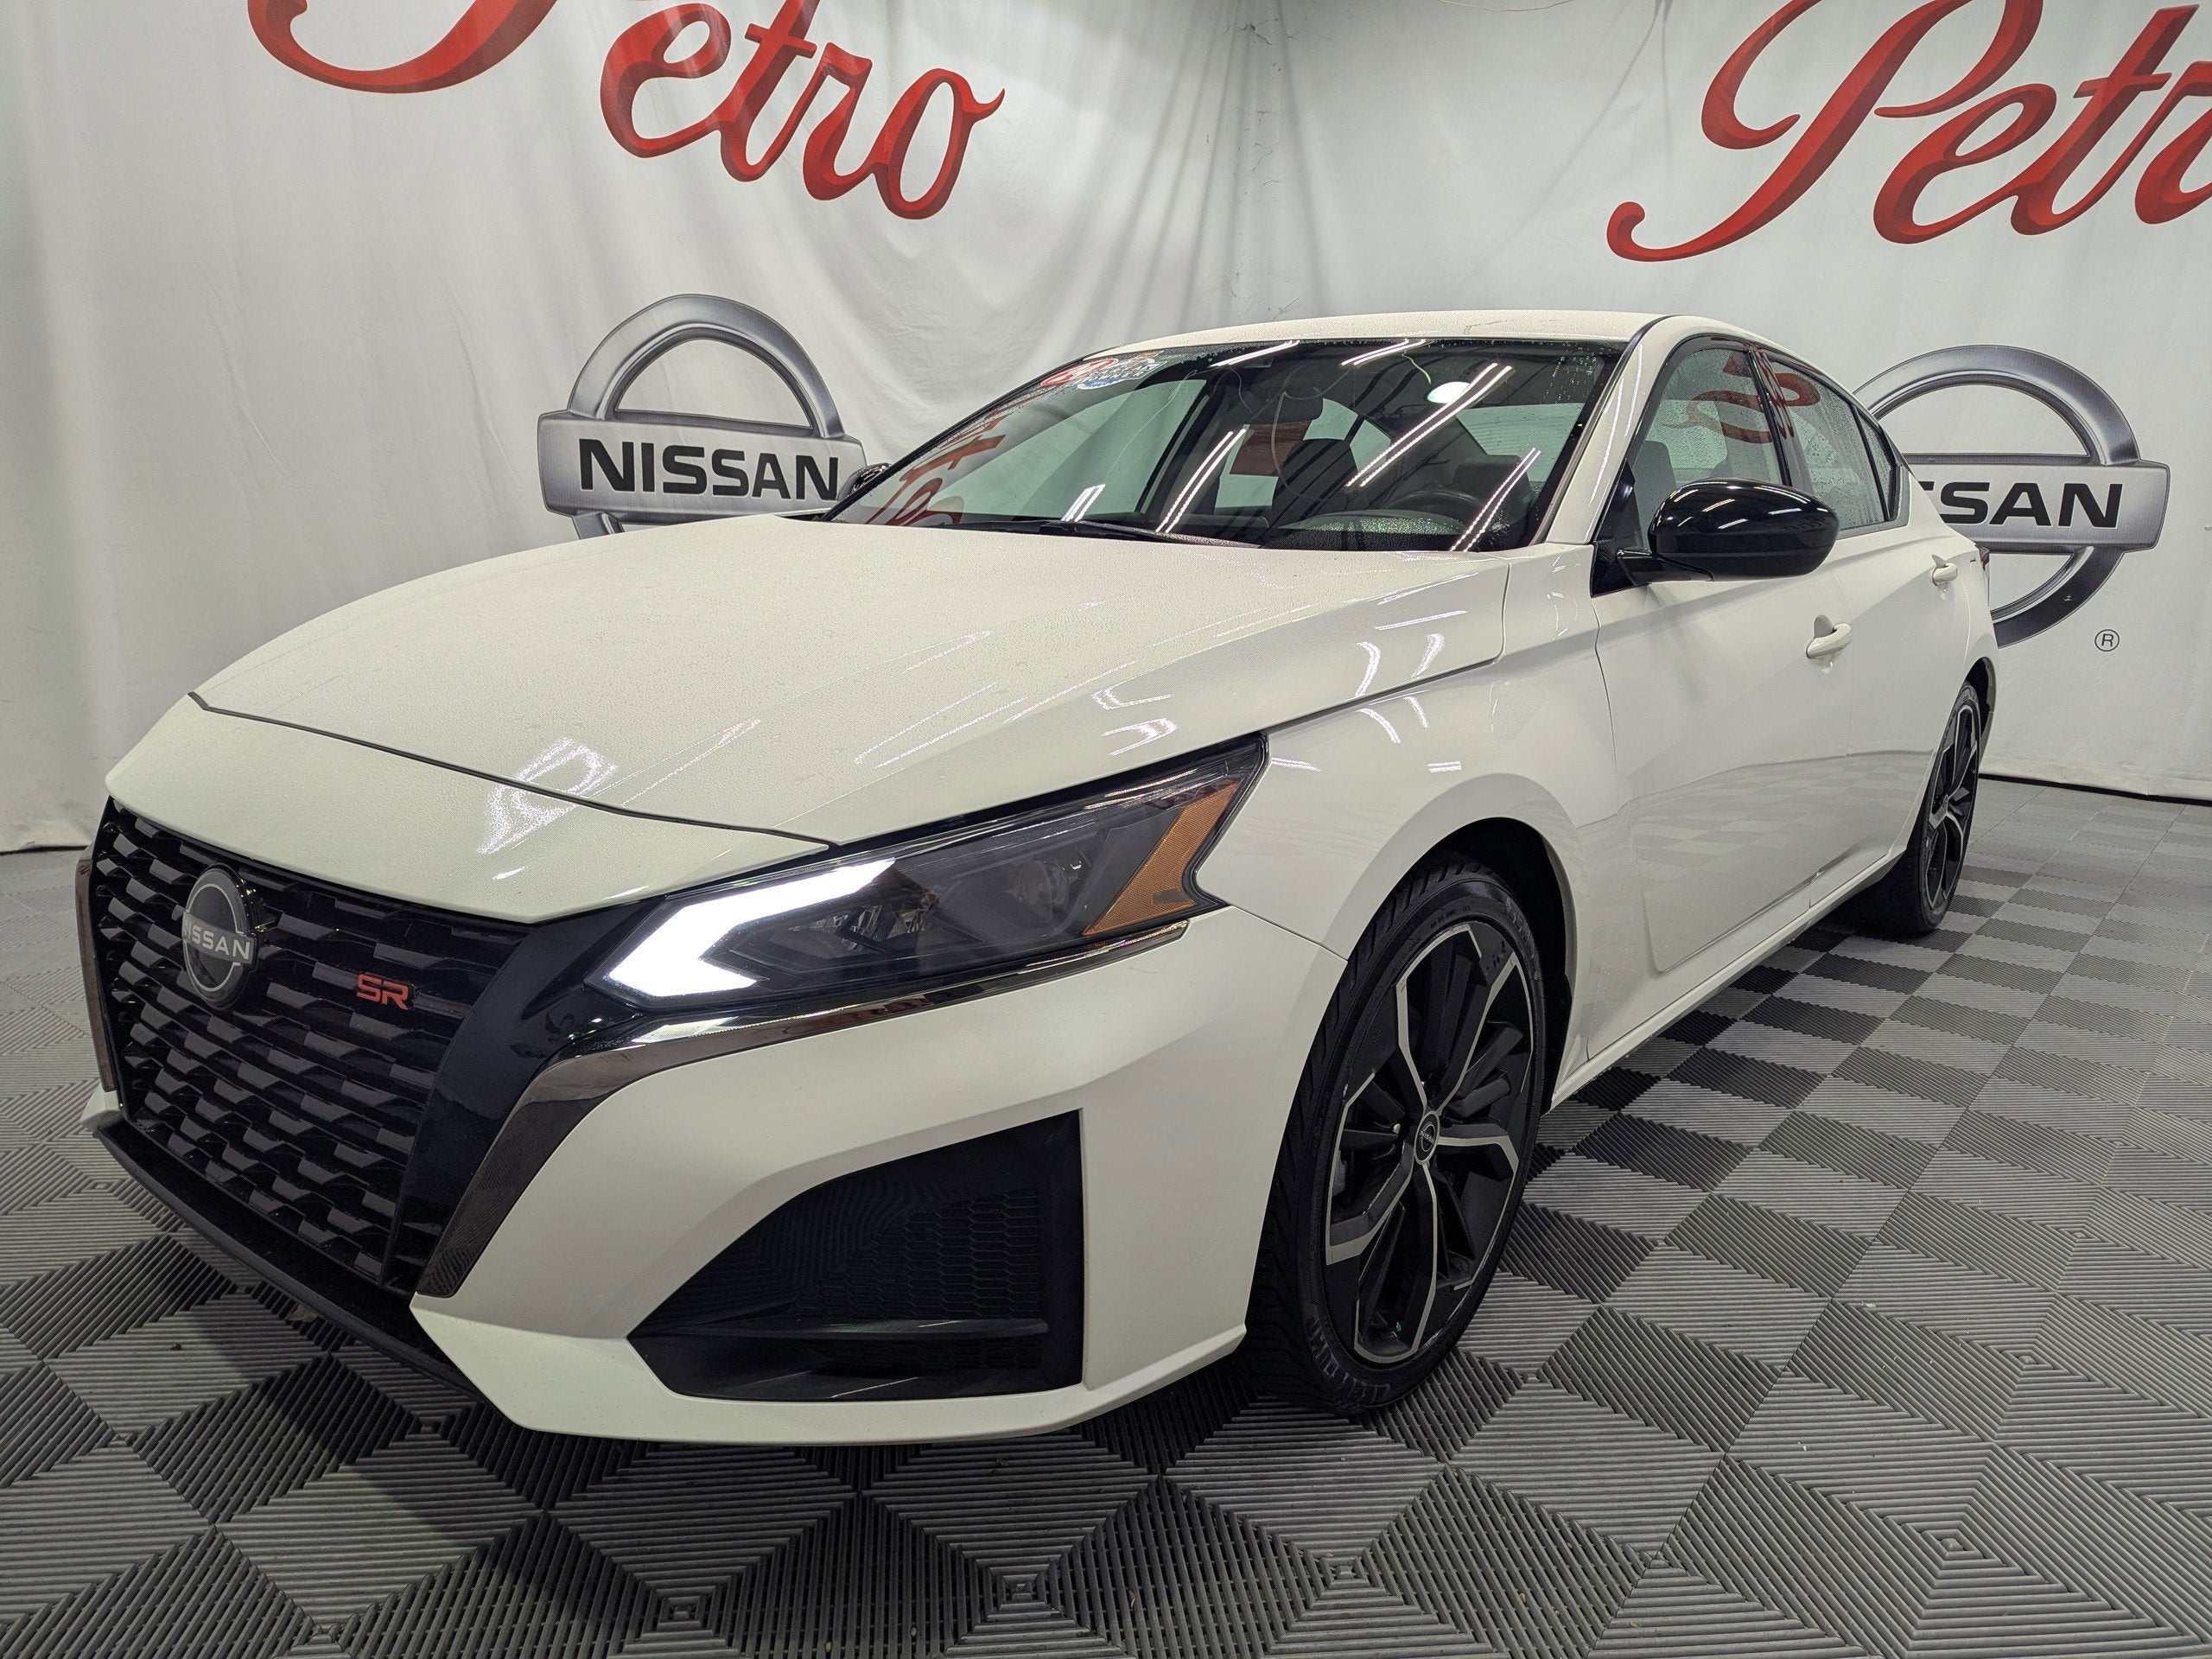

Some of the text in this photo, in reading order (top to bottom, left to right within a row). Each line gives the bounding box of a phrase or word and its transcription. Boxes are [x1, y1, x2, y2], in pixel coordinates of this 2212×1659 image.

[579, 438, 839, 500] NISSAN
[1918, 480, 2123, 528] SAN
[356, 974, 410, 1011] SR
